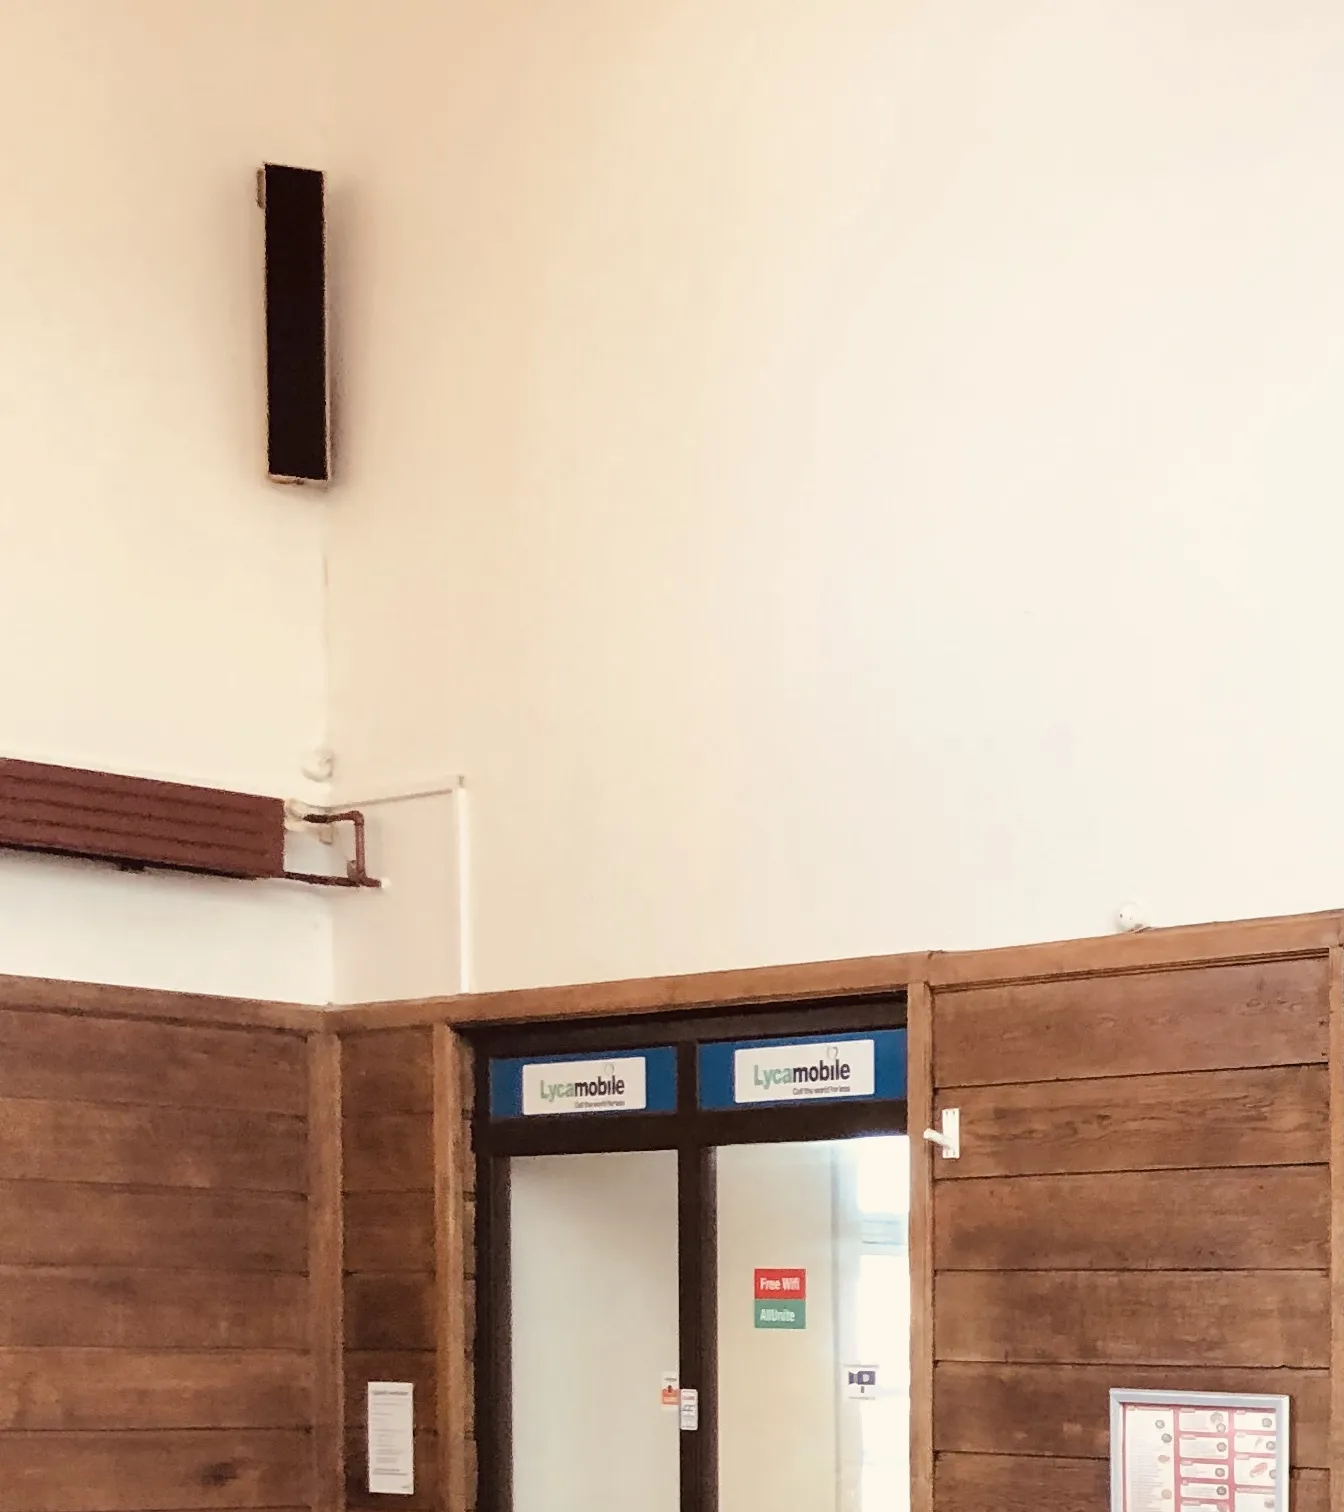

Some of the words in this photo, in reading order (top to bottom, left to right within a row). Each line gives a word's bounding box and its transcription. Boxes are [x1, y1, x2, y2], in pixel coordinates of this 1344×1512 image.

[753, 1059, 851, 1090] Lycamobile
[540, 1075, 625, 1102] Lycamobile
[760, 1277, 781, 1291] Free
